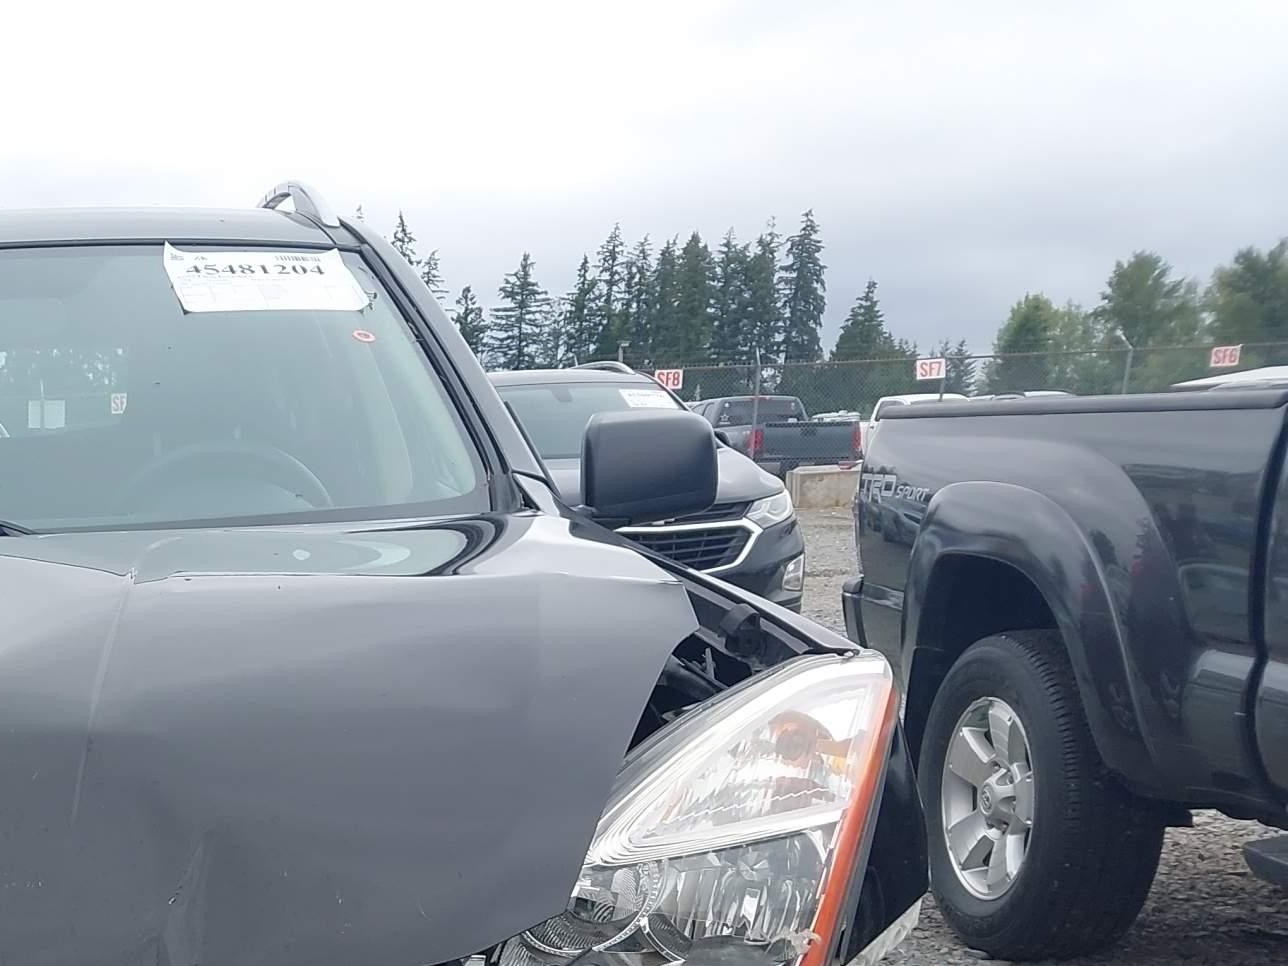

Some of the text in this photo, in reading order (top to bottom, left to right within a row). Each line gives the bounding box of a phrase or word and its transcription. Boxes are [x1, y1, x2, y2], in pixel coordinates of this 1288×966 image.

[186, 263, 325, 276] 45481204
[920, 361, 942, 377] SF7
[657, 371, 680, 387] SF8
[861, 473, 929, 503] TRD SPORT
